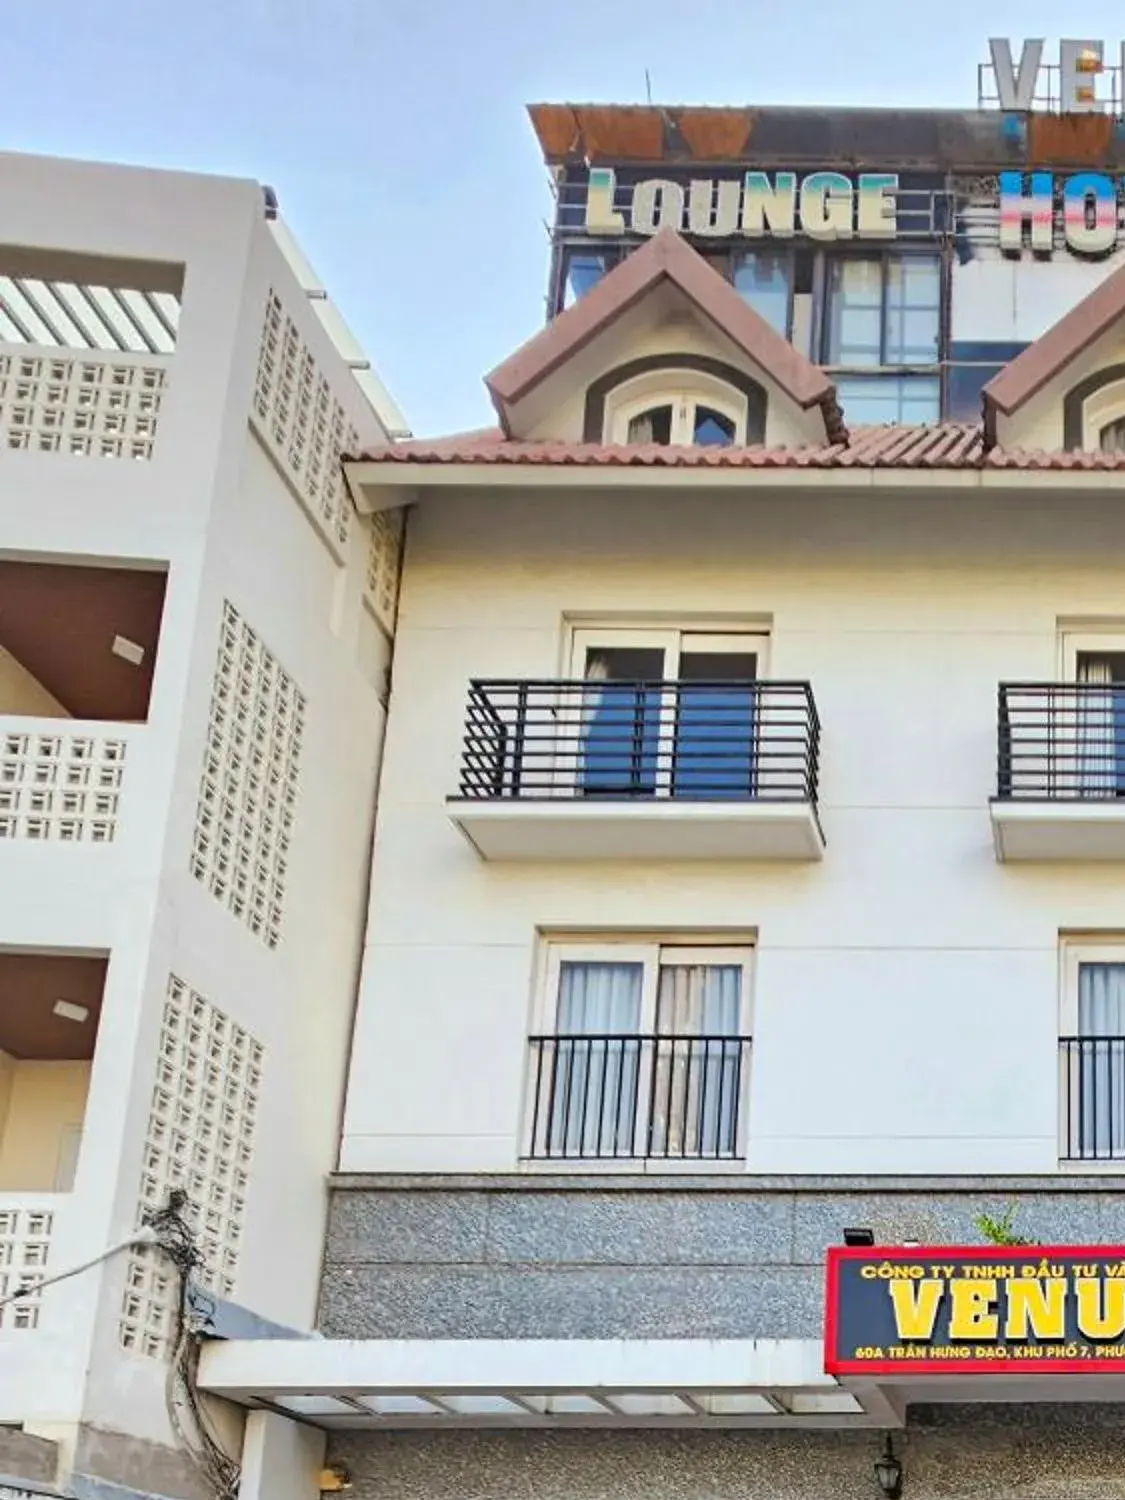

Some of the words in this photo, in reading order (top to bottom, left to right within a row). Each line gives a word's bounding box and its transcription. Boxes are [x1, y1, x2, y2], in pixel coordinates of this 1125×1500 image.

[585, 167, 899, 241] LOUNGE
[860, 1260, 925, 1279] CÔNG
[930, 1265, 955, 1278] TY
[961, 1264, 1015, 1278] TNHH
[1013, 1345, 1043, 1358] KHU
[1046, 1341, 1078, 1357] PHỐ
